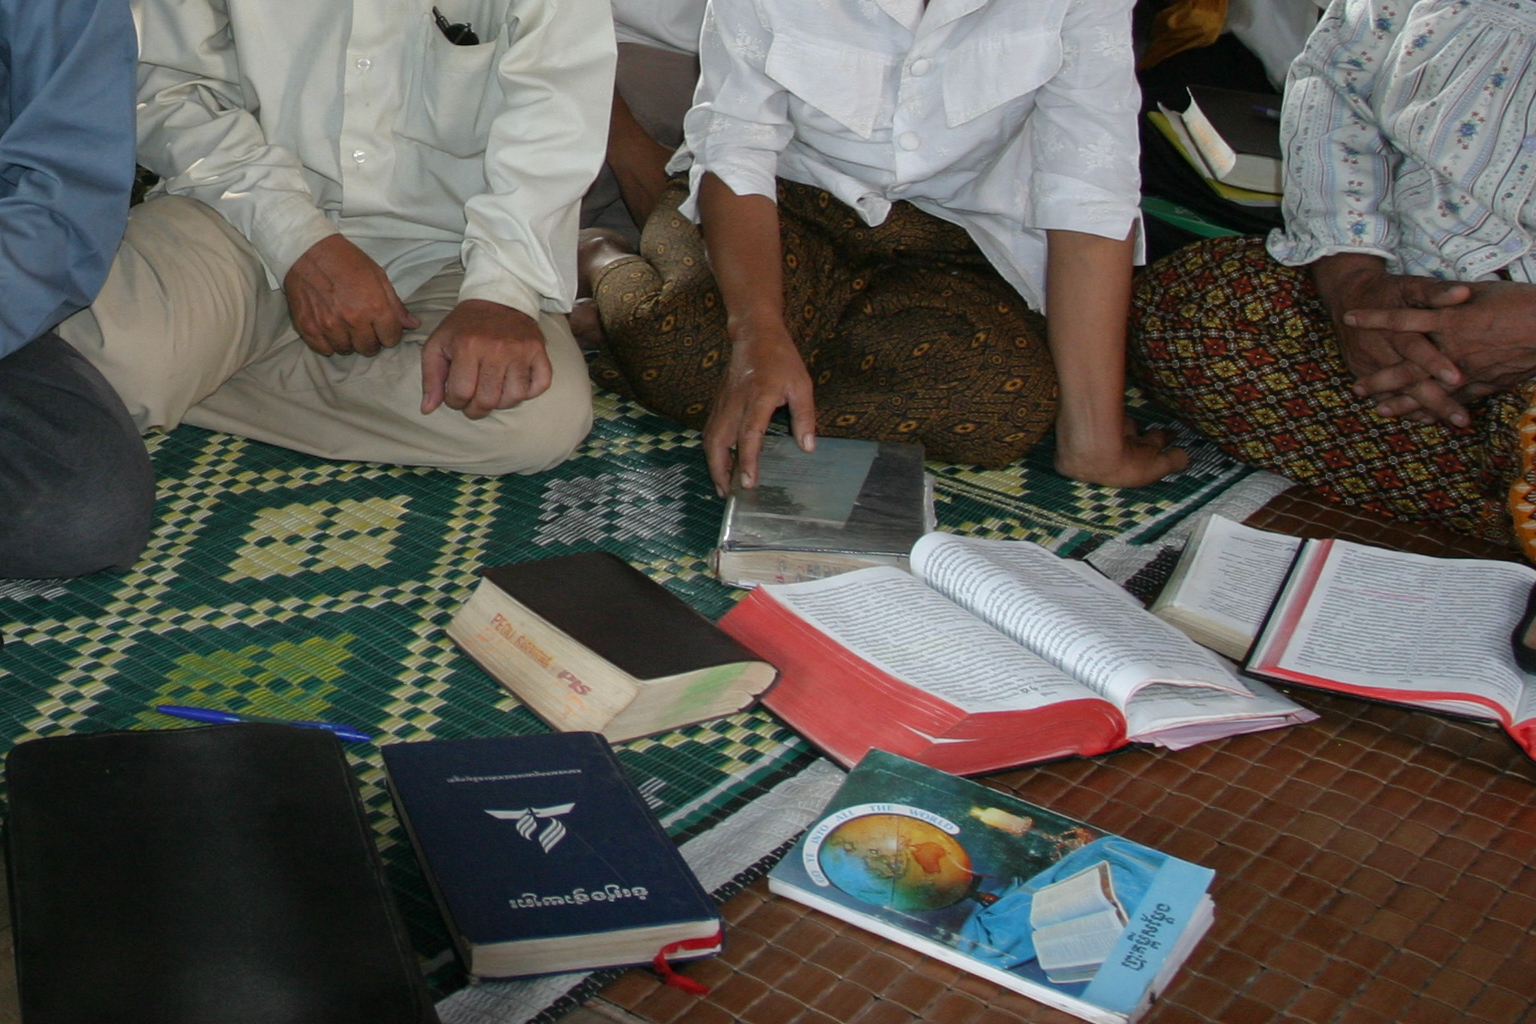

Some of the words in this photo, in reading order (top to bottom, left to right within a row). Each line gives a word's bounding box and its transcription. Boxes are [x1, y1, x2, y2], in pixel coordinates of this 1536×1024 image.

[811, 824, 830, 844] INTO
[835, 809, 856, 822] ALL
[869, 804, 894, 812] THE
[909, 808, 955, 832] WORLD
